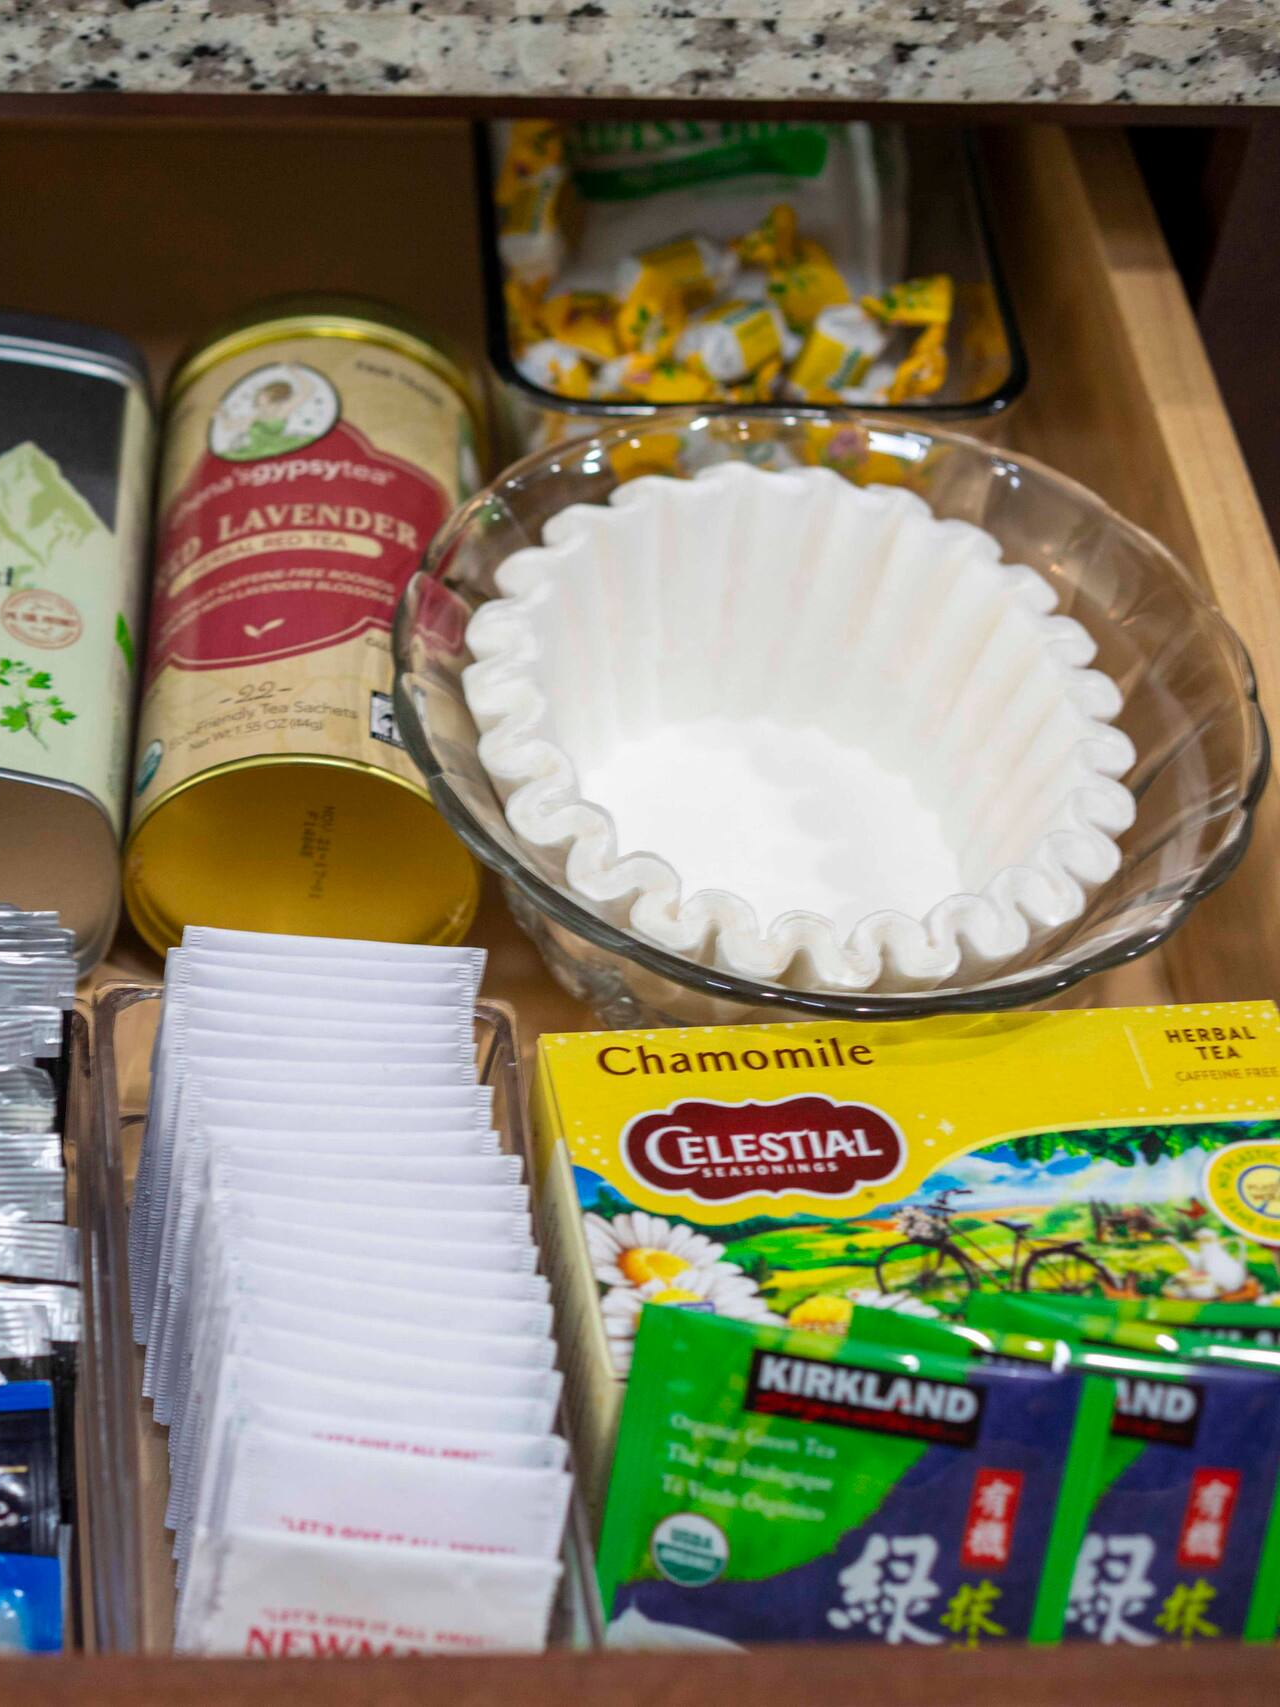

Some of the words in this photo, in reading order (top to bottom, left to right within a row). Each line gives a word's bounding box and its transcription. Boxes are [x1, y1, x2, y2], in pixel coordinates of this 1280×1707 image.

[218, 503, 418, 551] LAVENDER
[260, 703, 289, 715] Tea
[1164, 1026, 1258, 1043] HERBAL
[597, 1037, 876, 1076] Chamomile
[1194, 1045, 1243, 1060] TEA
[1175, 1068, 1241, 1081] CAFFEINE
[645, 1126, 884, 1175] CELESTIAL
[702, 1161, 839, 1178] SEASONINGS
[757, 1355, 980, 1424] KIRKLAND
[670, 1528, 713, 1550] USDA
